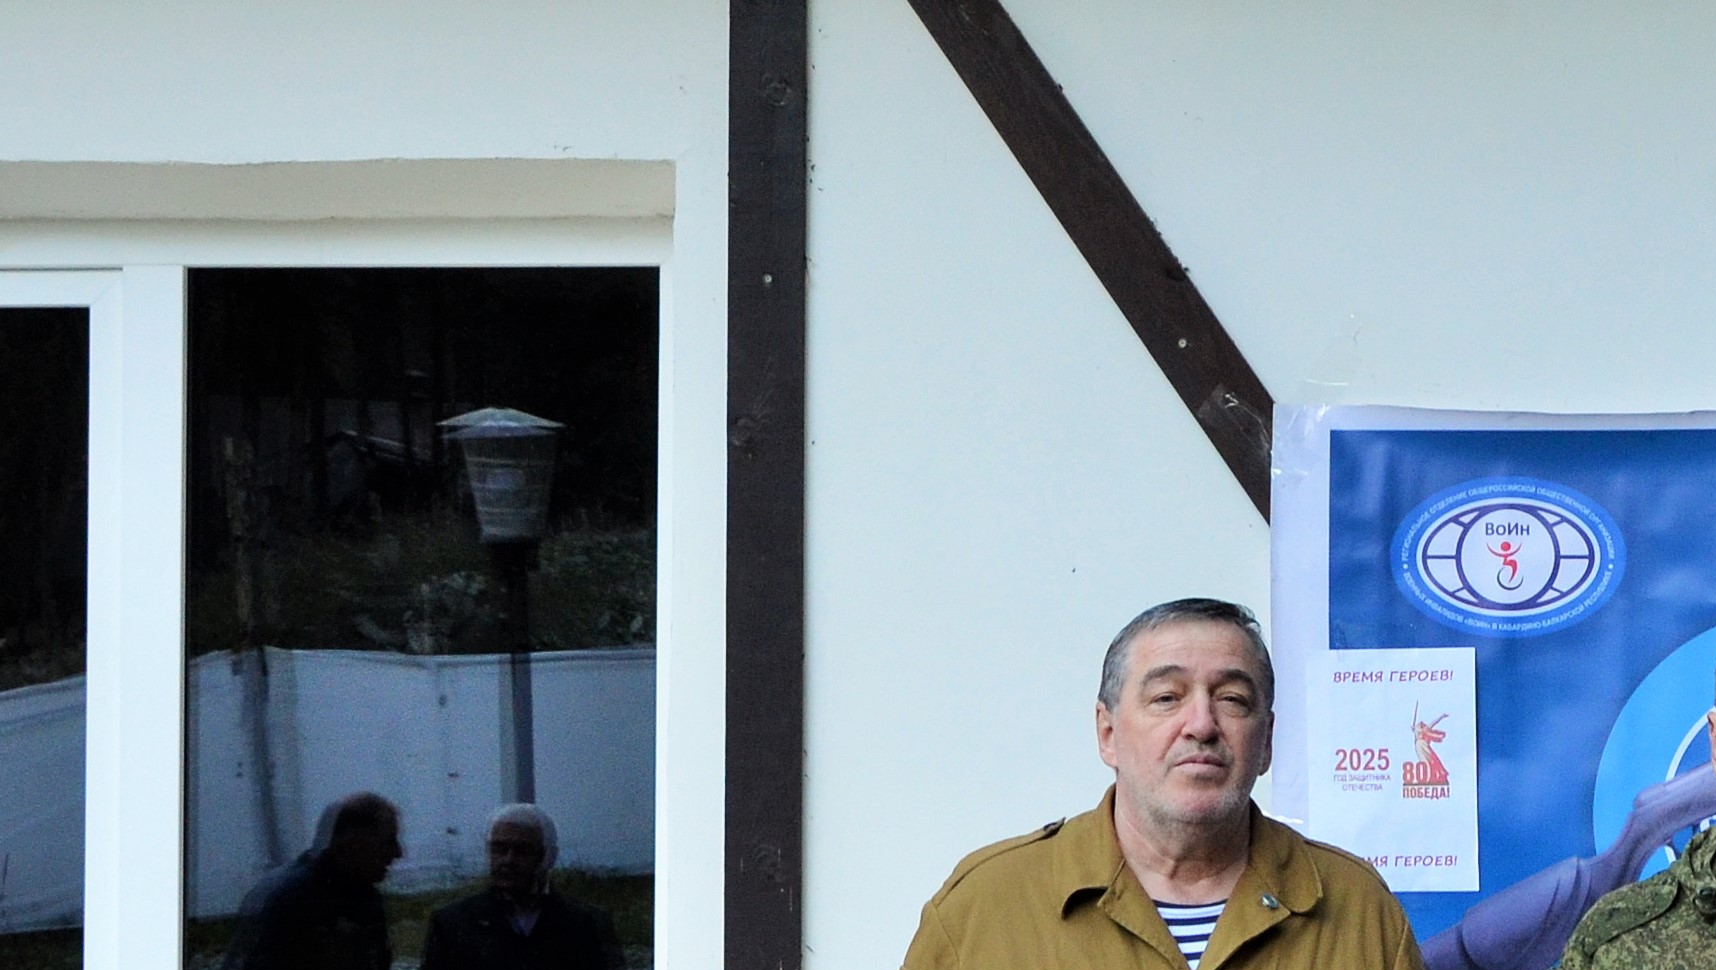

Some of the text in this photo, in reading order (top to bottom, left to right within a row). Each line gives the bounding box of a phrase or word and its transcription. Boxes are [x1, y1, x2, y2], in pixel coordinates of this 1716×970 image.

[1485, 522, 1530, 536] ВоИн
[1333, 669, 1454, 683] ВРЕМЯ ГЕРОЕВ!
[1334, 748, 1390, 771] 2025
[1333, 774, 1347, 782] ГОД
[1402, 761, 1429, 784] 80
[1402, 786, 1450, 800] ПОБЕДА!
[1394, 855, 1458, 868] ГЕРОЕВ!
